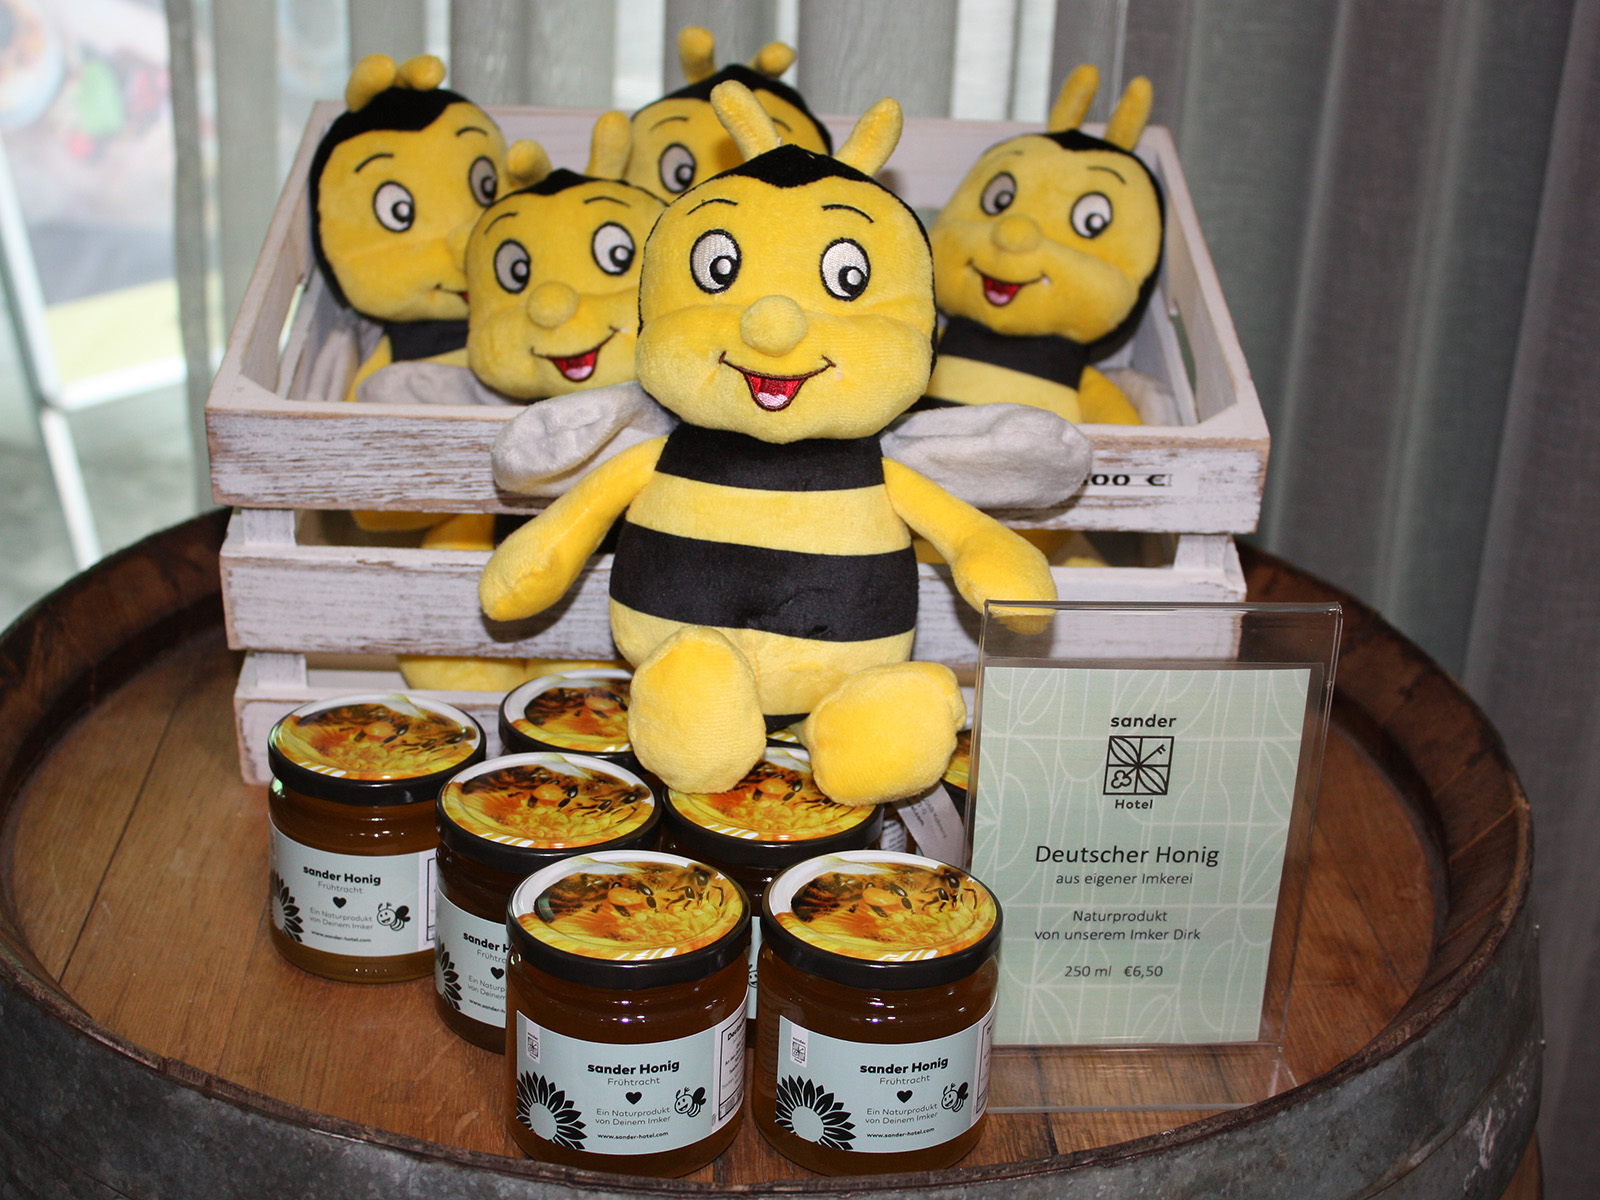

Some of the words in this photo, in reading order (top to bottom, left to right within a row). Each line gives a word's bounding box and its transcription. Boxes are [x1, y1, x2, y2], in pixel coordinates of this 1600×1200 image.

[1110, 714, 1177, 728] sander
[1114, 799, 1154, 810] Hotel
[1035, 845, 1150, 863] Deutscher
[1156, 846, 1220, 868] Honig
[303, 866, 341, 881] sander
[344, 873, 381, 886] Honig
[1056, 875, 1080, 885] aus
[1084, 873, 1138, 887] eigener
[1141, 872, 1193, 885] Imkerei
[318, 881, 363, 894] Frühtracht
[310, 907, 320, 915] Ein
[322, 910, 373, 922] Naturprodukt
[1073, 910, 1168, 923] Naturprodukt
[322, 918, 351, 928] Deinem
[1035, 931, 1060, 941] von
[1064, 930, 1126, 941] unserem
[1130, 929, 1169, 941] Imker
[1173, 928, 1201, 941] Dirk
[463, 932, 500, 951] sander
[476, 949, 507, 964] Frühtra
[1065, 965, 1090, 977] 250
[1095, 965, 1111, 977] ml
[1124, 965, 1163, 979] €6,50
[468, 975, 480, 984] Ein
[480, 980, 506, 993] Naturp
[468, 984, 479, 993] von
[587, 1064, 637, 1075] sander
[639, 1060, 680, 1075] Honig
[859, 1064, 909, 1075] sander
[911, 1057, 949, 1073] Honig
[607, 1077, 661, 1087] Frühtracht
[879, 1074, 931, 1085] Frühtracht
[596, 1108, 609, 1116] Ein
[611, 1107, 671, 1118] Naturprodukt
[866, 1107, 880, 1115] Ein
[882, 1103, 938, 1116] Naturprodukt
[612, 1118, 645, 1126] Deinem
[647, 1115, 671, 1125] Imker
[916, 1112, 938, 1121] Imker
[597, 1131, 669, 1140] www.sander-hotel.com
[866, 1127, 935, 1138] www.sander-hotel.com
